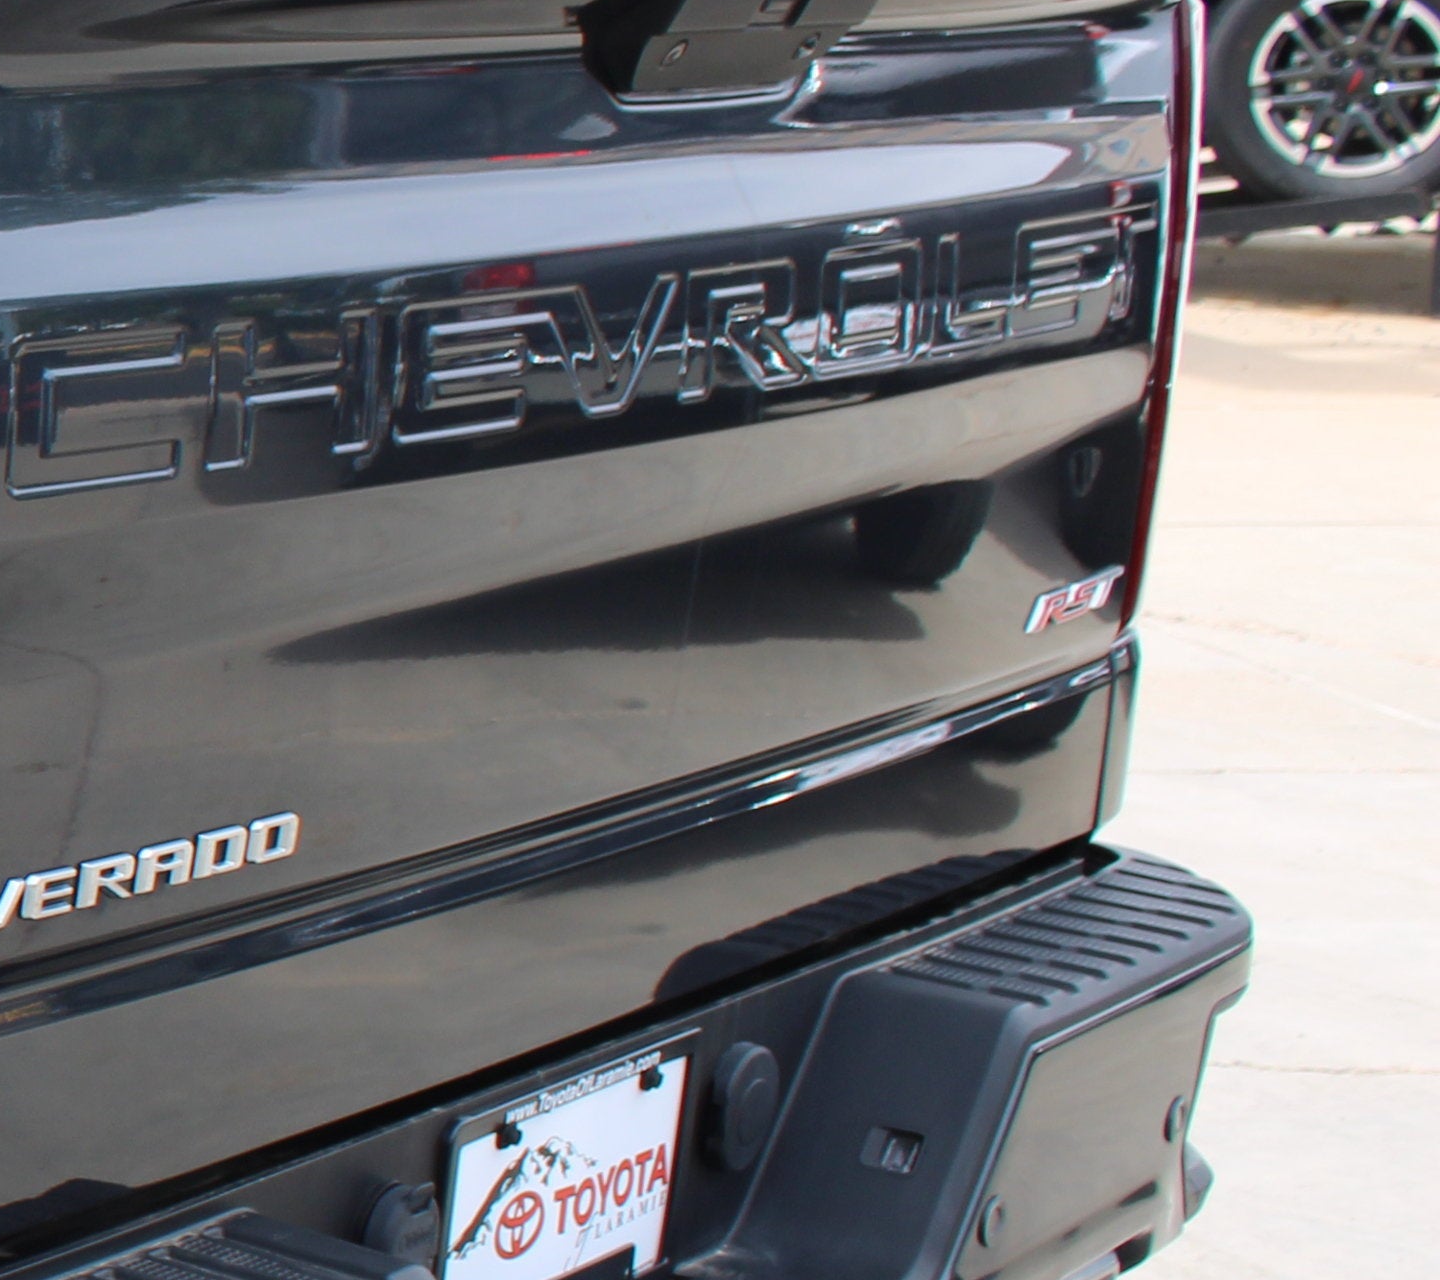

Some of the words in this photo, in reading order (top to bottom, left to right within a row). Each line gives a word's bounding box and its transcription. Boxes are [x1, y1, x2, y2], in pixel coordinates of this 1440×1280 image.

[5, 202, 1157, 501] CHEVROLET
[1023, 564, 1126, 634] RST
[553, 1142, 669, 1235] TOYOTA
[593, 1190, 667, 1240] LARAMIE
